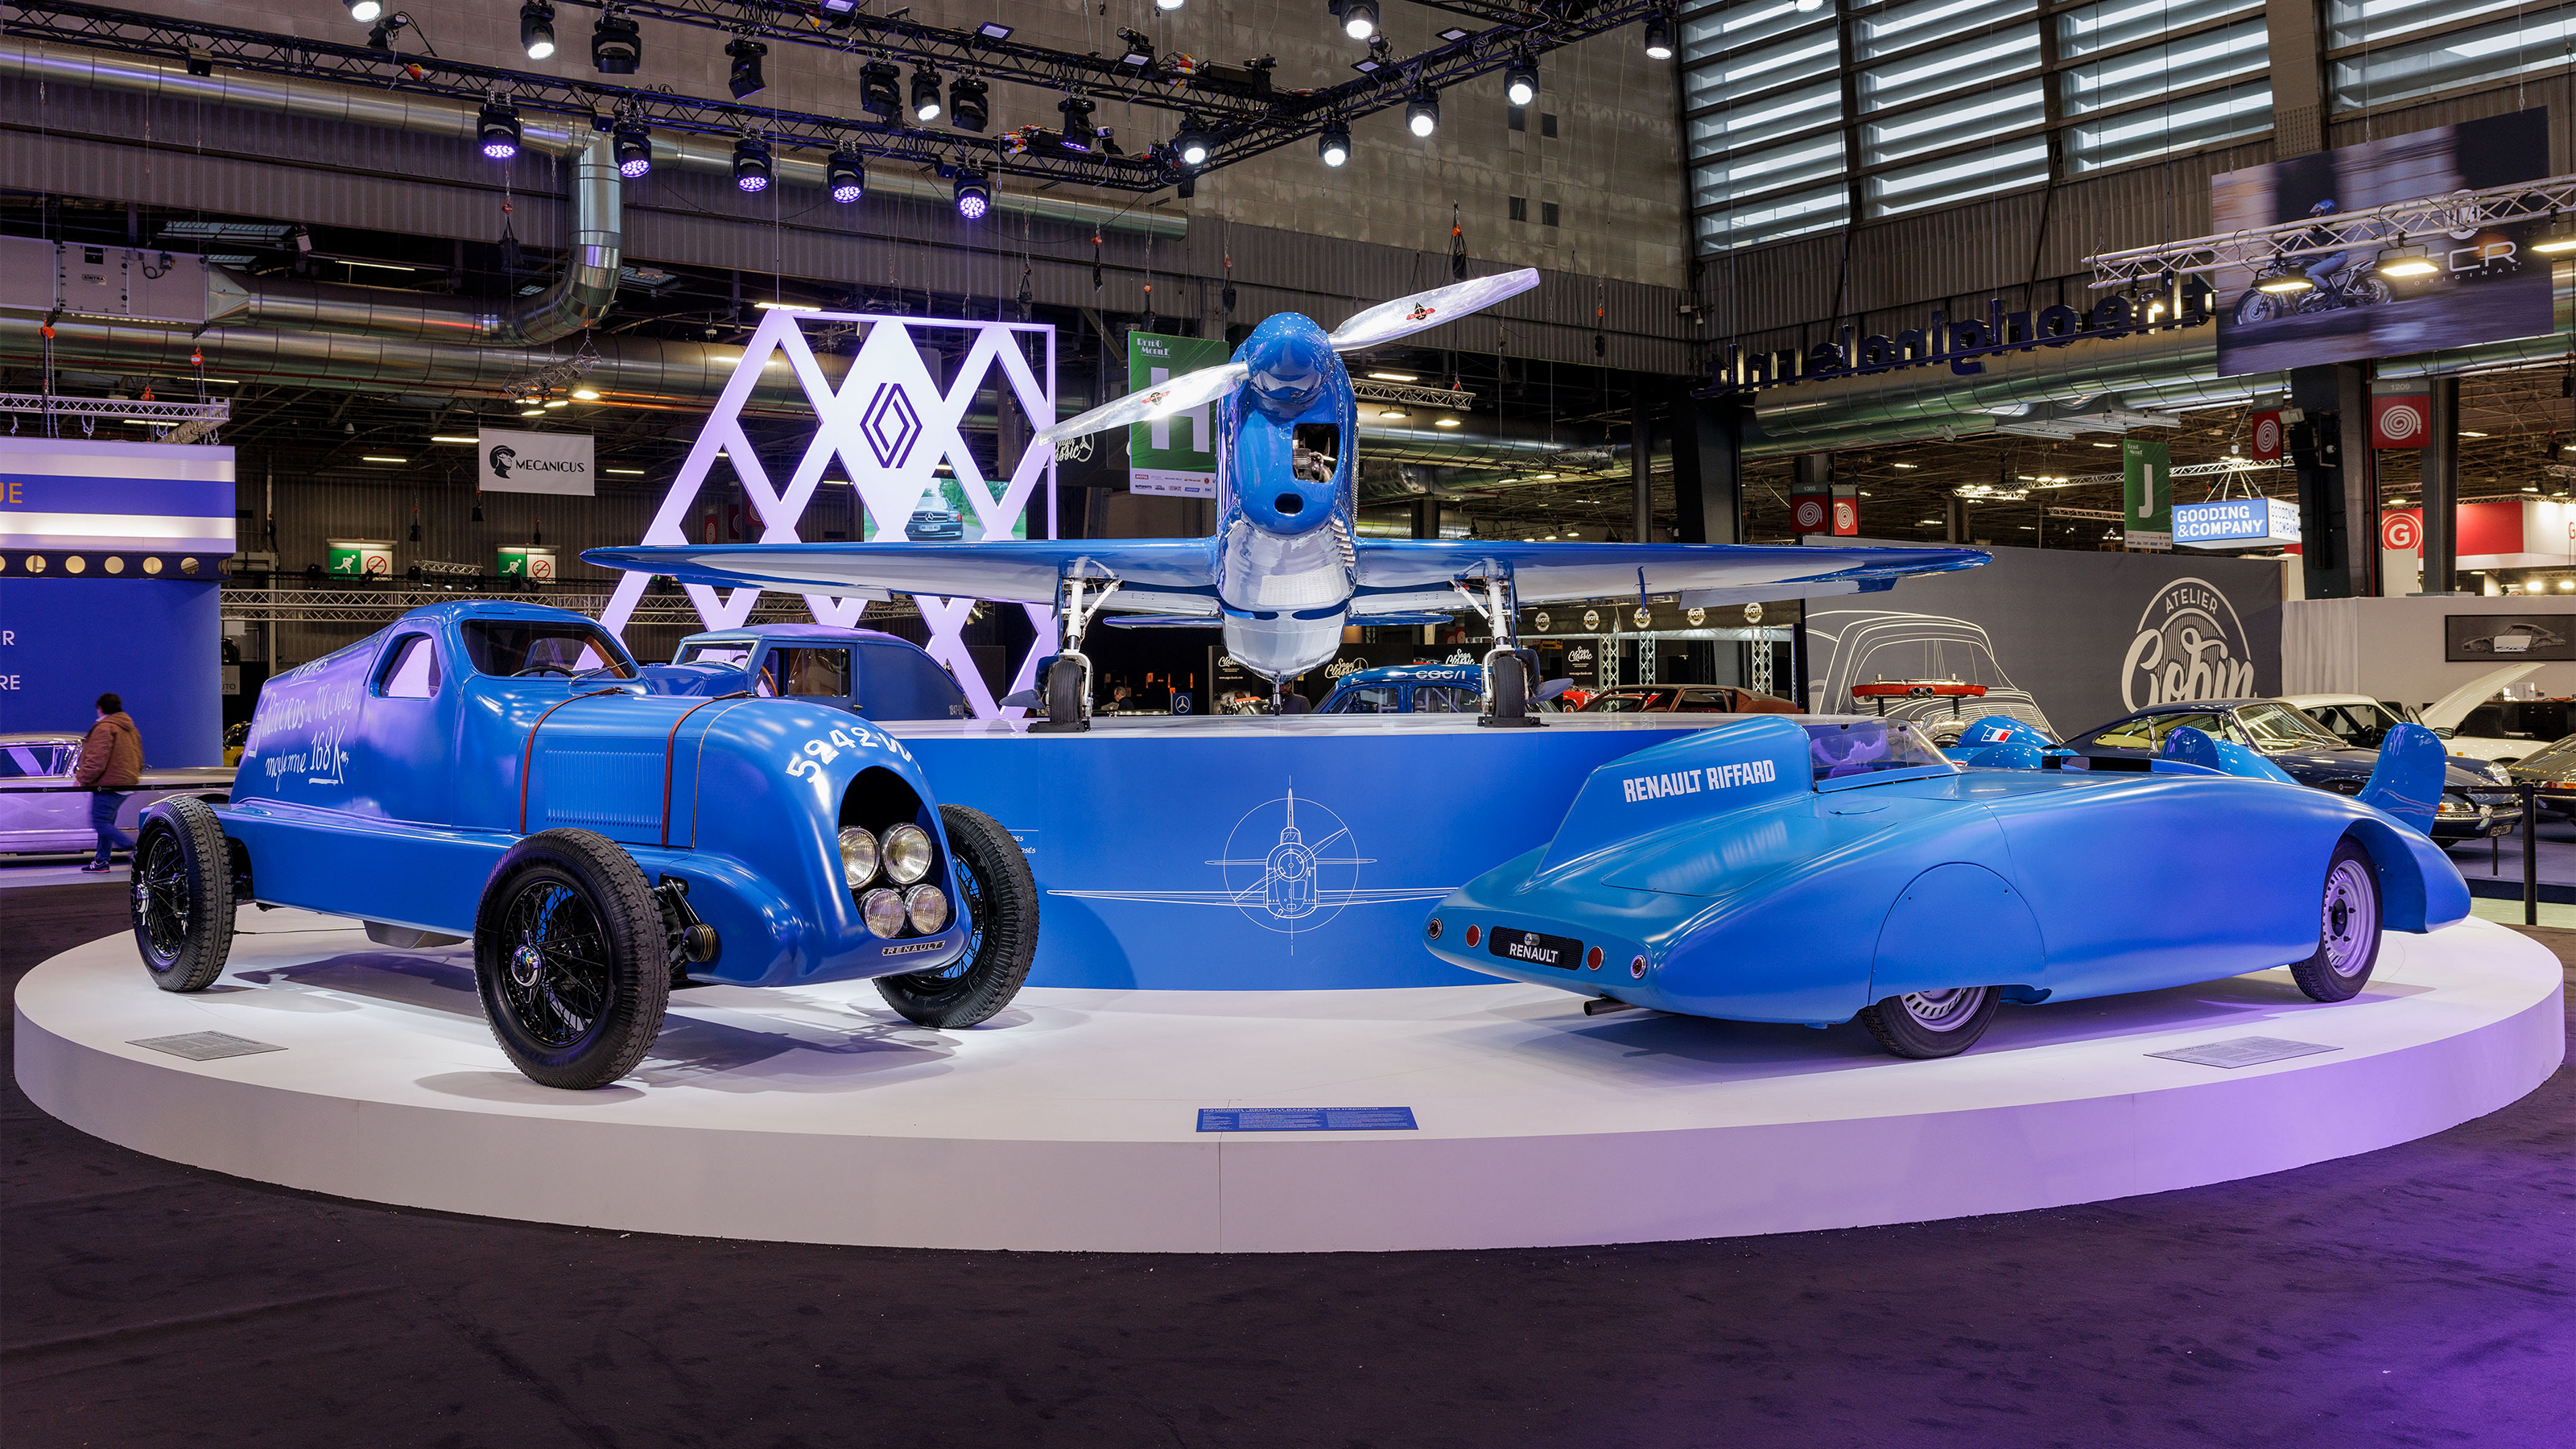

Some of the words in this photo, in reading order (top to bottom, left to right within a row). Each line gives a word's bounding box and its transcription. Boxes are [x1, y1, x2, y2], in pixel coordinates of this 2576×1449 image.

[2425, 242, 2517, 272] CR
[2415, 266, 2518, 286] ORIGINAL
[516, 459, 585, 473] MECANICUS
[2138, 463, 2153, 518] J
[2178, 505, 2250, 523] GOODING
[2178, 519, 2263, 538] &COMPANY
[2388, 523, 2410, 546] G
[2165, 588, 2219, 615] ATELIER
[785, 726, 923, 784] 5942-W
[1623, 770, 1702, 803] RENAULT
[1706, 759, 1776, 791] RIFFARD
[887, 942, 939, 955] RENAULT
[1509, 942, 1559, 964] RENAULT
